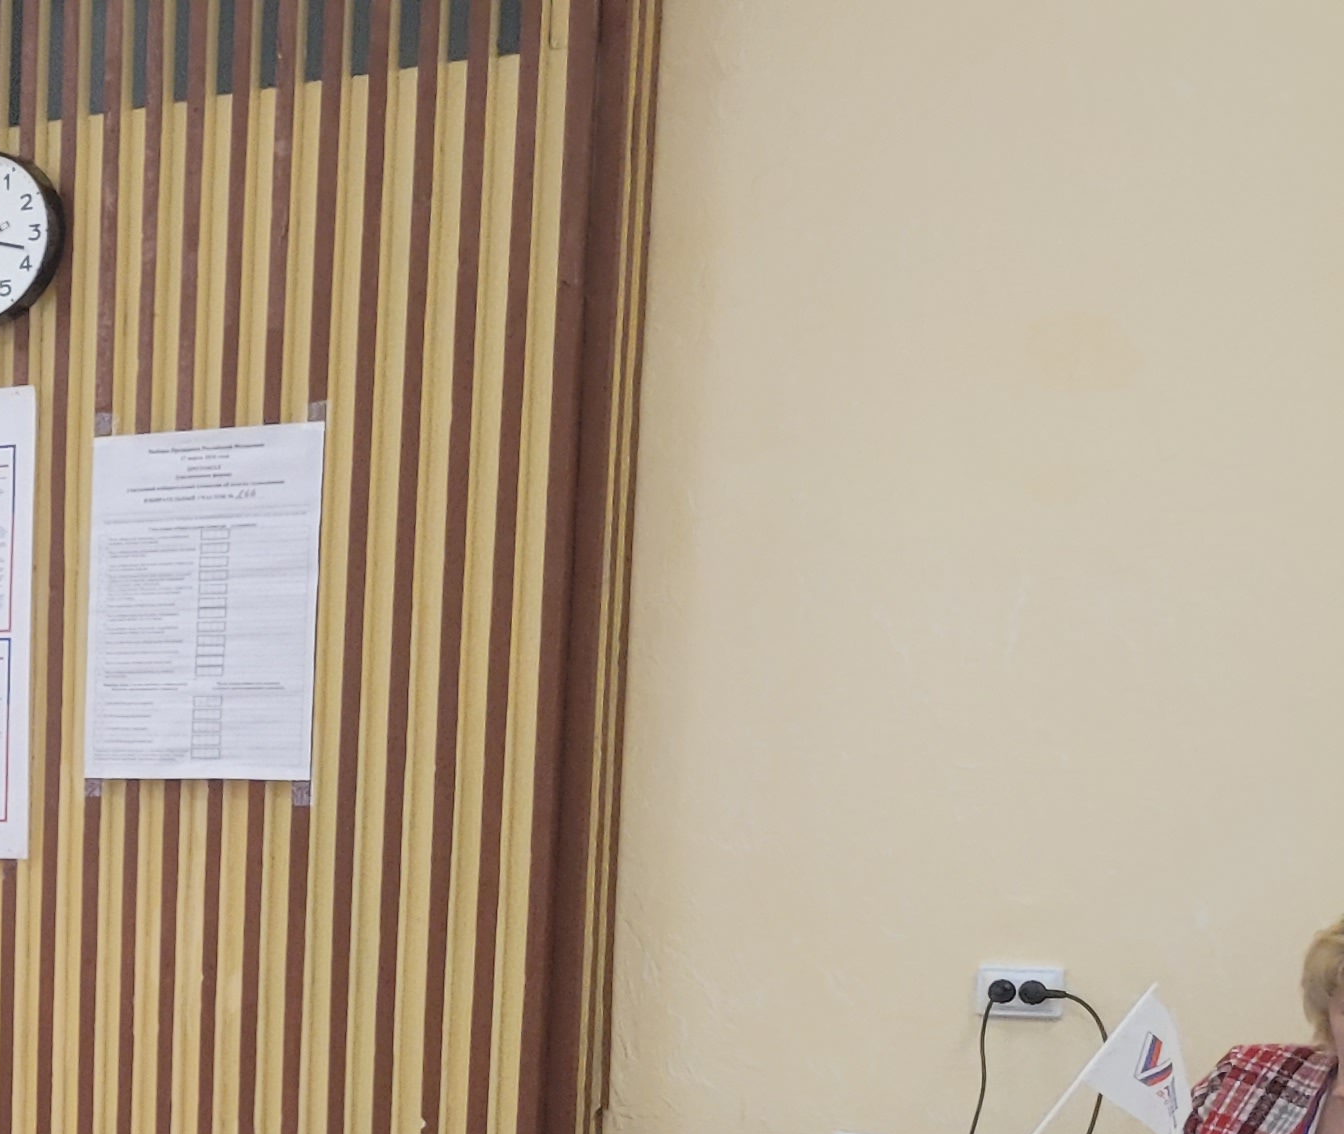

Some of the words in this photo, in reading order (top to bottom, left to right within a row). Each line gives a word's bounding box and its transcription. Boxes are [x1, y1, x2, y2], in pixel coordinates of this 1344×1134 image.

[20, 193, 33, 211] 2
[28, 223, 41, 241] 3
[19, 255, 32, 272] 4
[0, 279, 12, 297] 5
